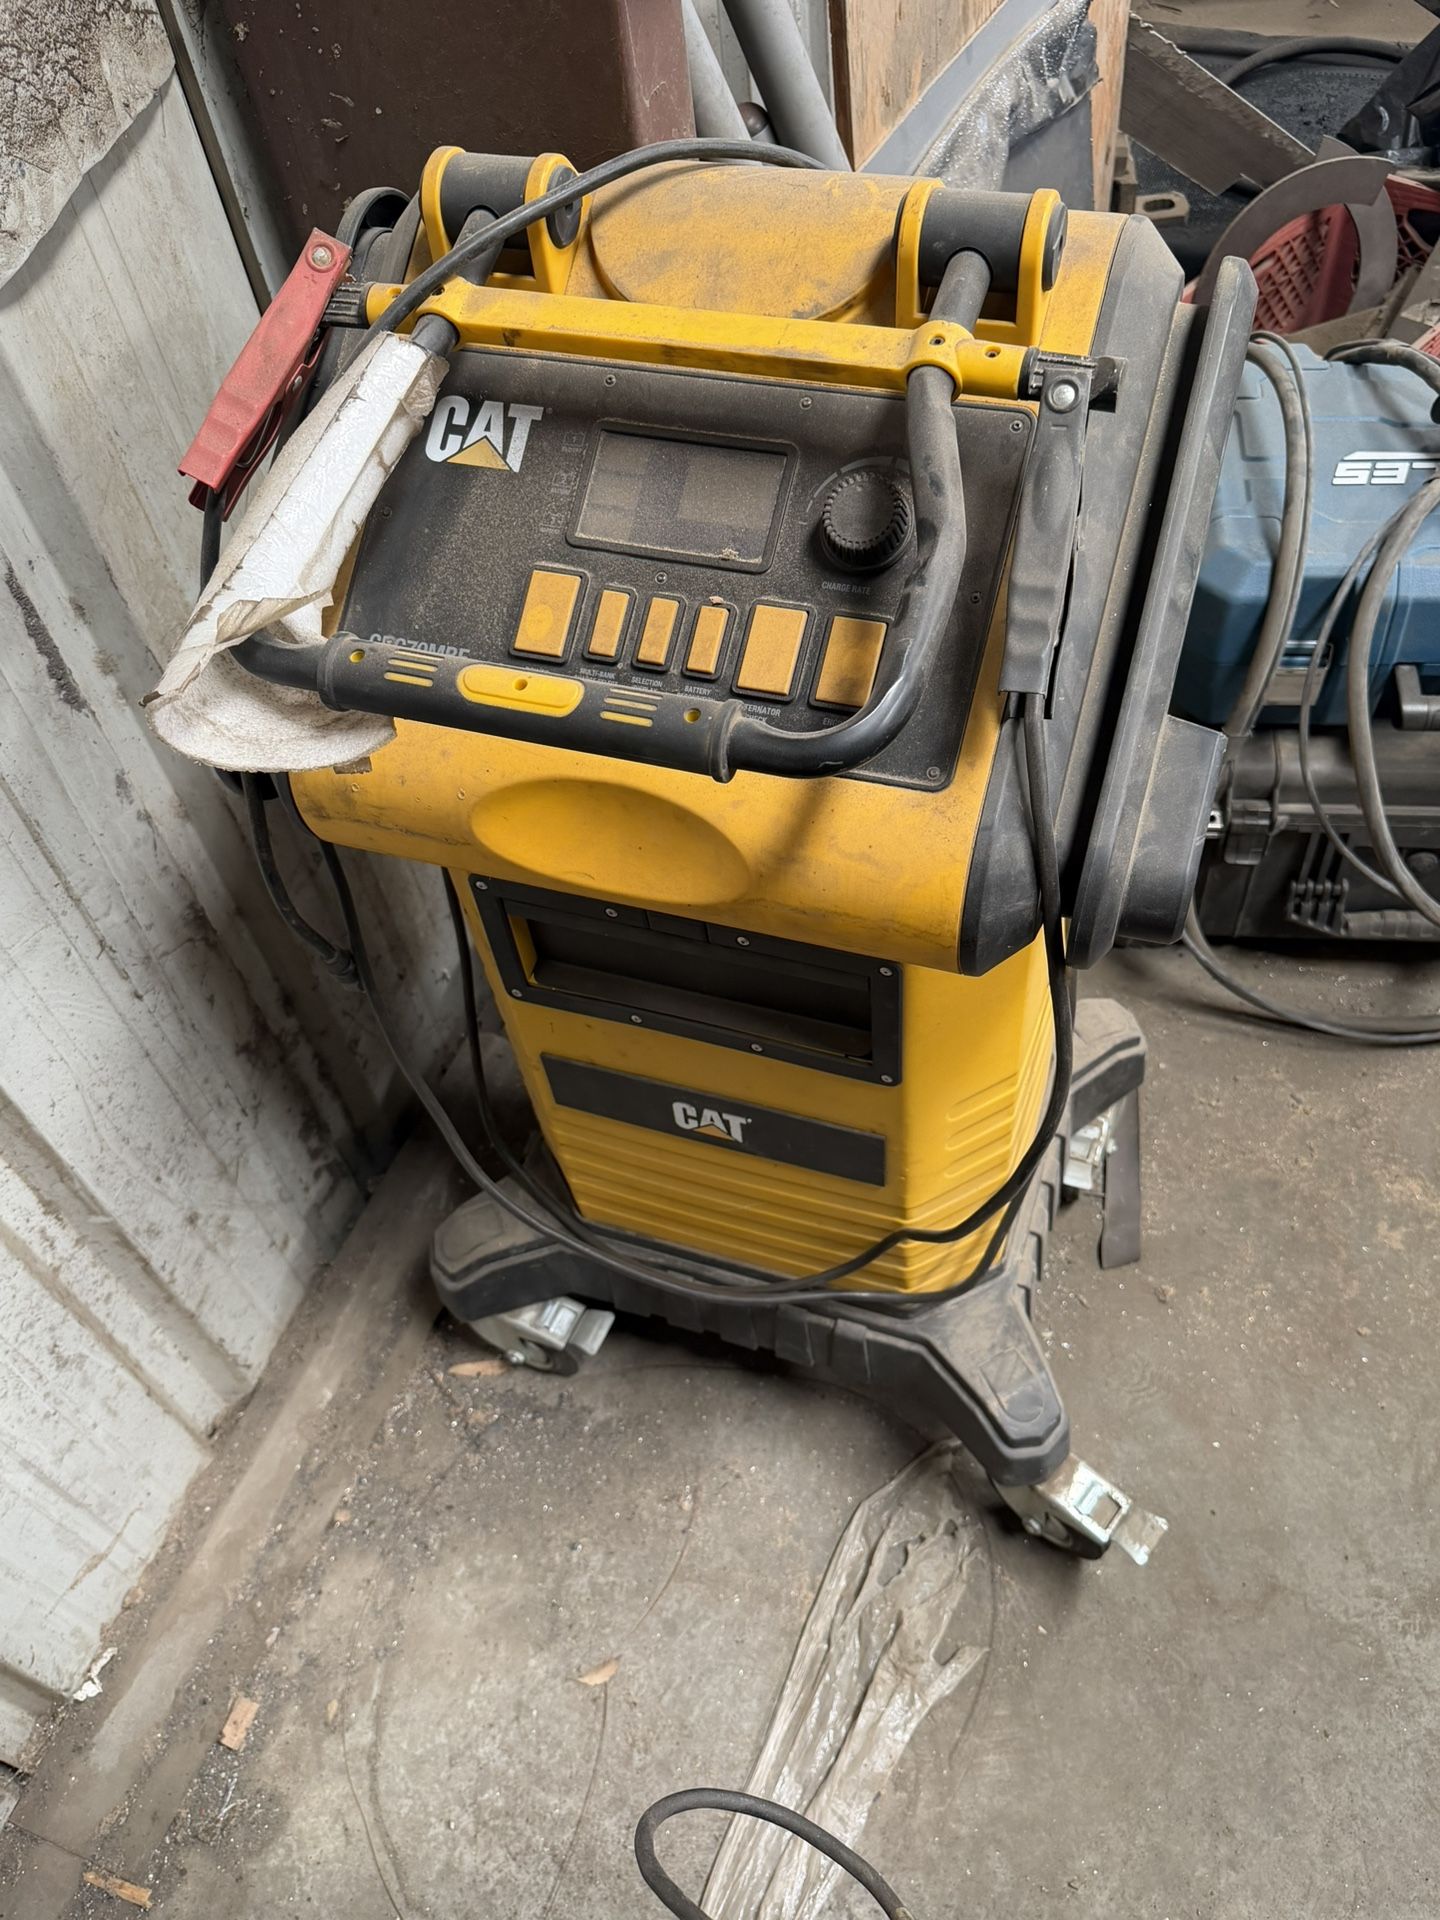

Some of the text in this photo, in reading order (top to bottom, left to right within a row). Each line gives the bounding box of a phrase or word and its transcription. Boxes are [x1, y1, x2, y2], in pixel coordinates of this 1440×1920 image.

[425, 395, 544, 473] CAT
[821, 581, 872, 594] CHARGE RATE
[631, 676, 663, 688] SELECTION
[684, 685, 711, 696] BATTERY
[672, 1102, 747, 1143] CAT
